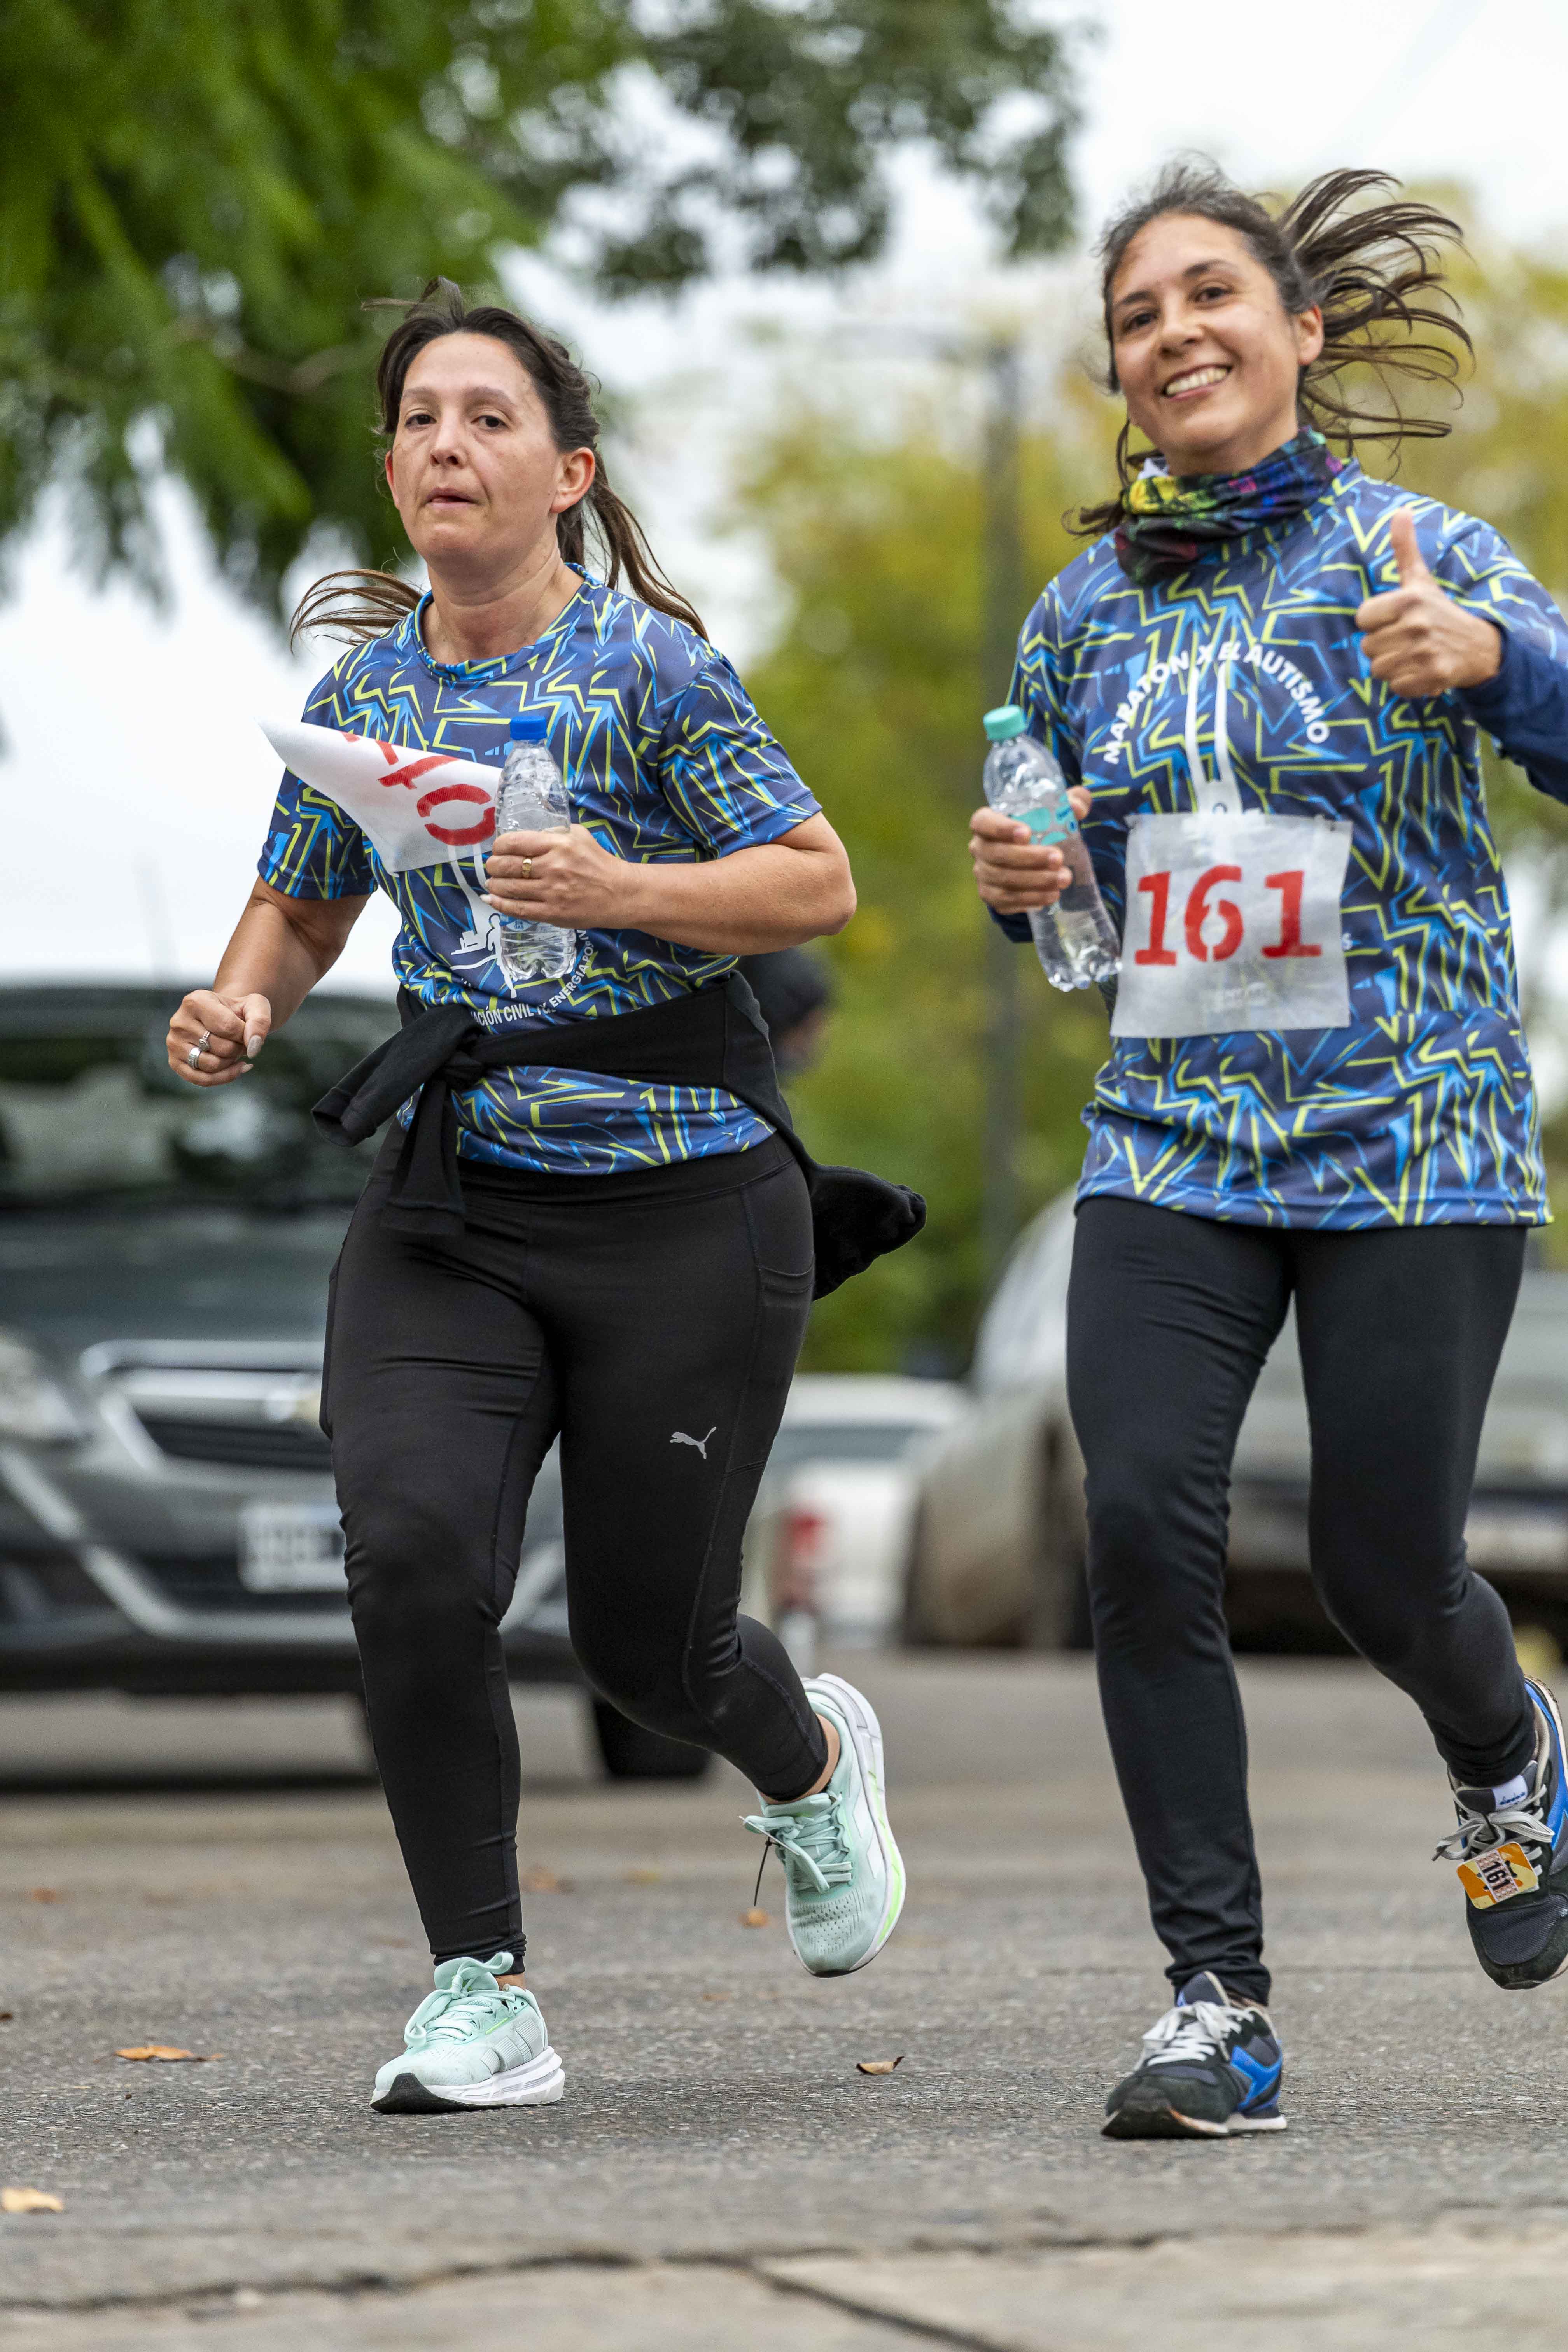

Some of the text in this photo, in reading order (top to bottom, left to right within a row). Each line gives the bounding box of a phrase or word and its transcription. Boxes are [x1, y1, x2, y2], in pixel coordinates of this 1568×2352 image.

[1103, 641, 1330, 765] MARATON X EL AUTISMO
[1134, 864, 1322, 967] 161
[504, 1003, 535, 1022] CIVIL
[1482, 1860, 1510, 1891] 161
